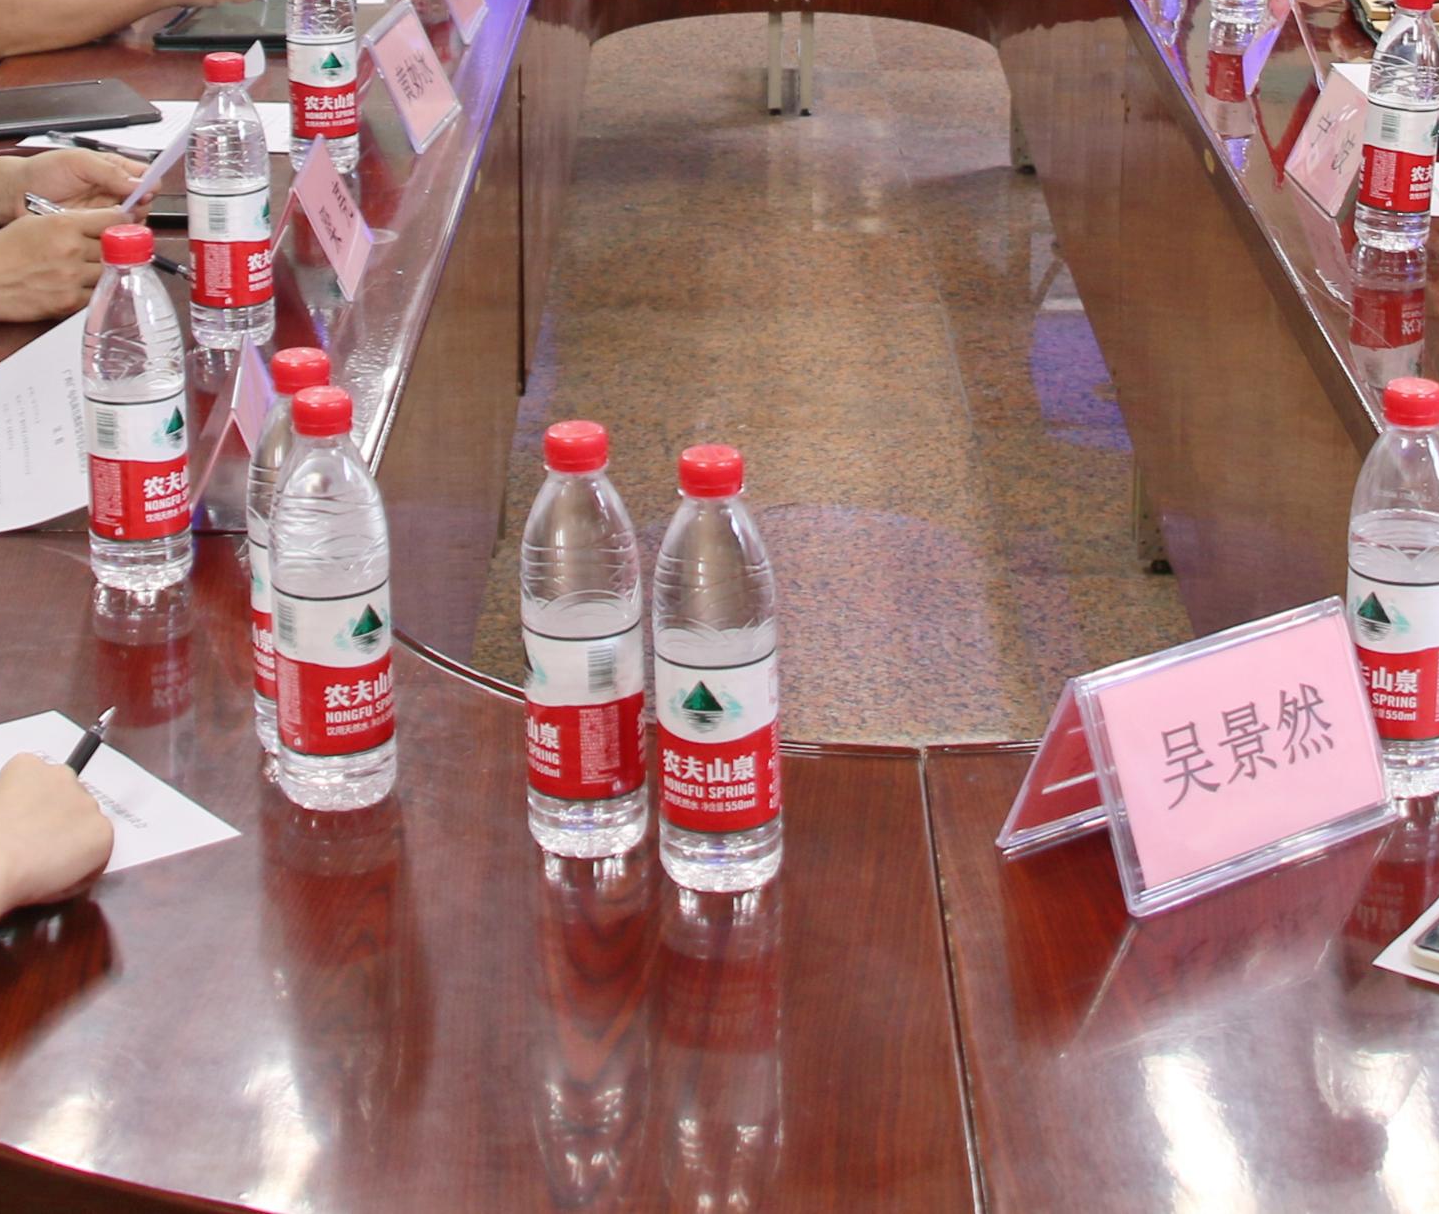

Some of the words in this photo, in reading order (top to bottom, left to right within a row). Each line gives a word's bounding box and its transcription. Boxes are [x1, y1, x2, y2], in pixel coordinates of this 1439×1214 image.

[1372, 692, 1418, 709] SPRING
[325, 705, 373, 724] NONGFU
[1161, 681, 1336, 812] 吴景然
[663, 748, 757, 785] 农夫山泉
[708, 782, 756, 800] SPRING
